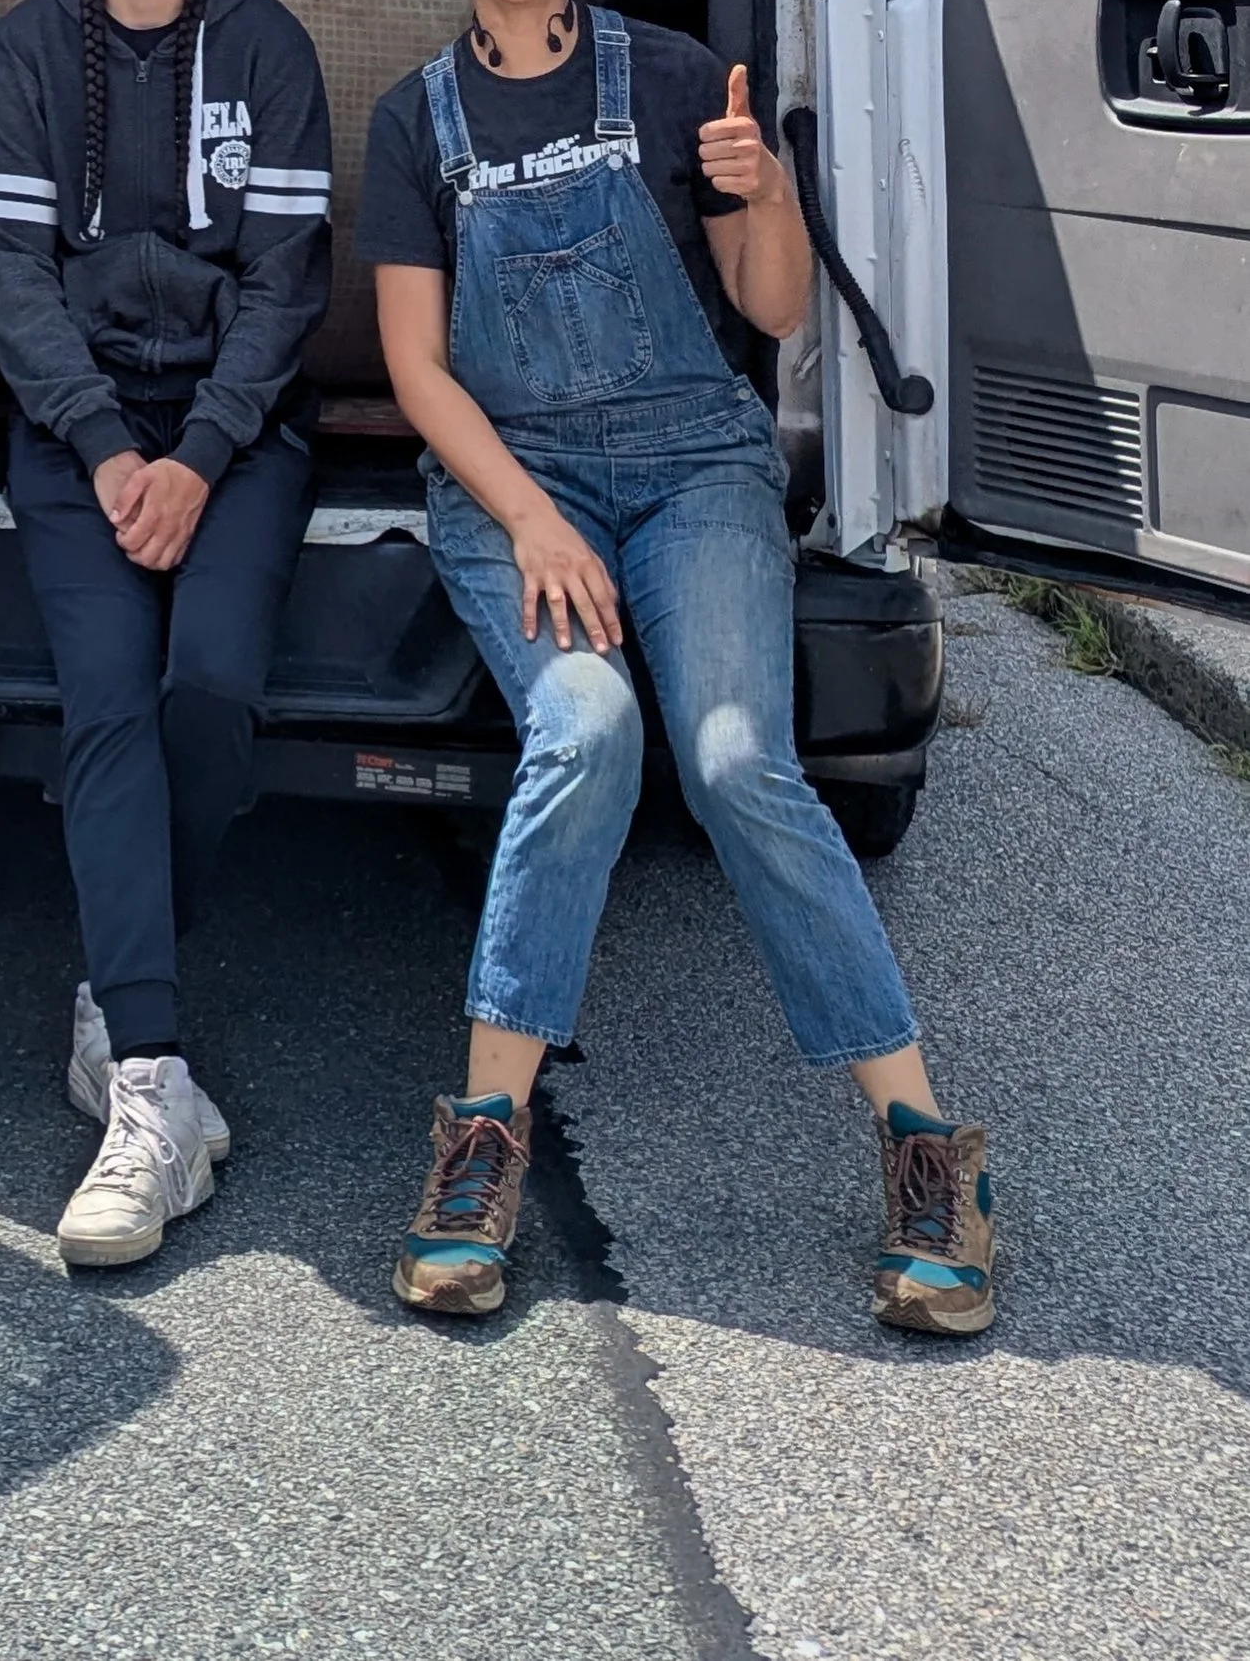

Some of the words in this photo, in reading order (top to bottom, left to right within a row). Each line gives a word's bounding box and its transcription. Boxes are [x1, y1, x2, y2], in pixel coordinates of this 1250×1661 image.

[201, 100, 252, 139] ELA
[469, 160, 516, 190] the
[521, 137, 641, 180] Factory
